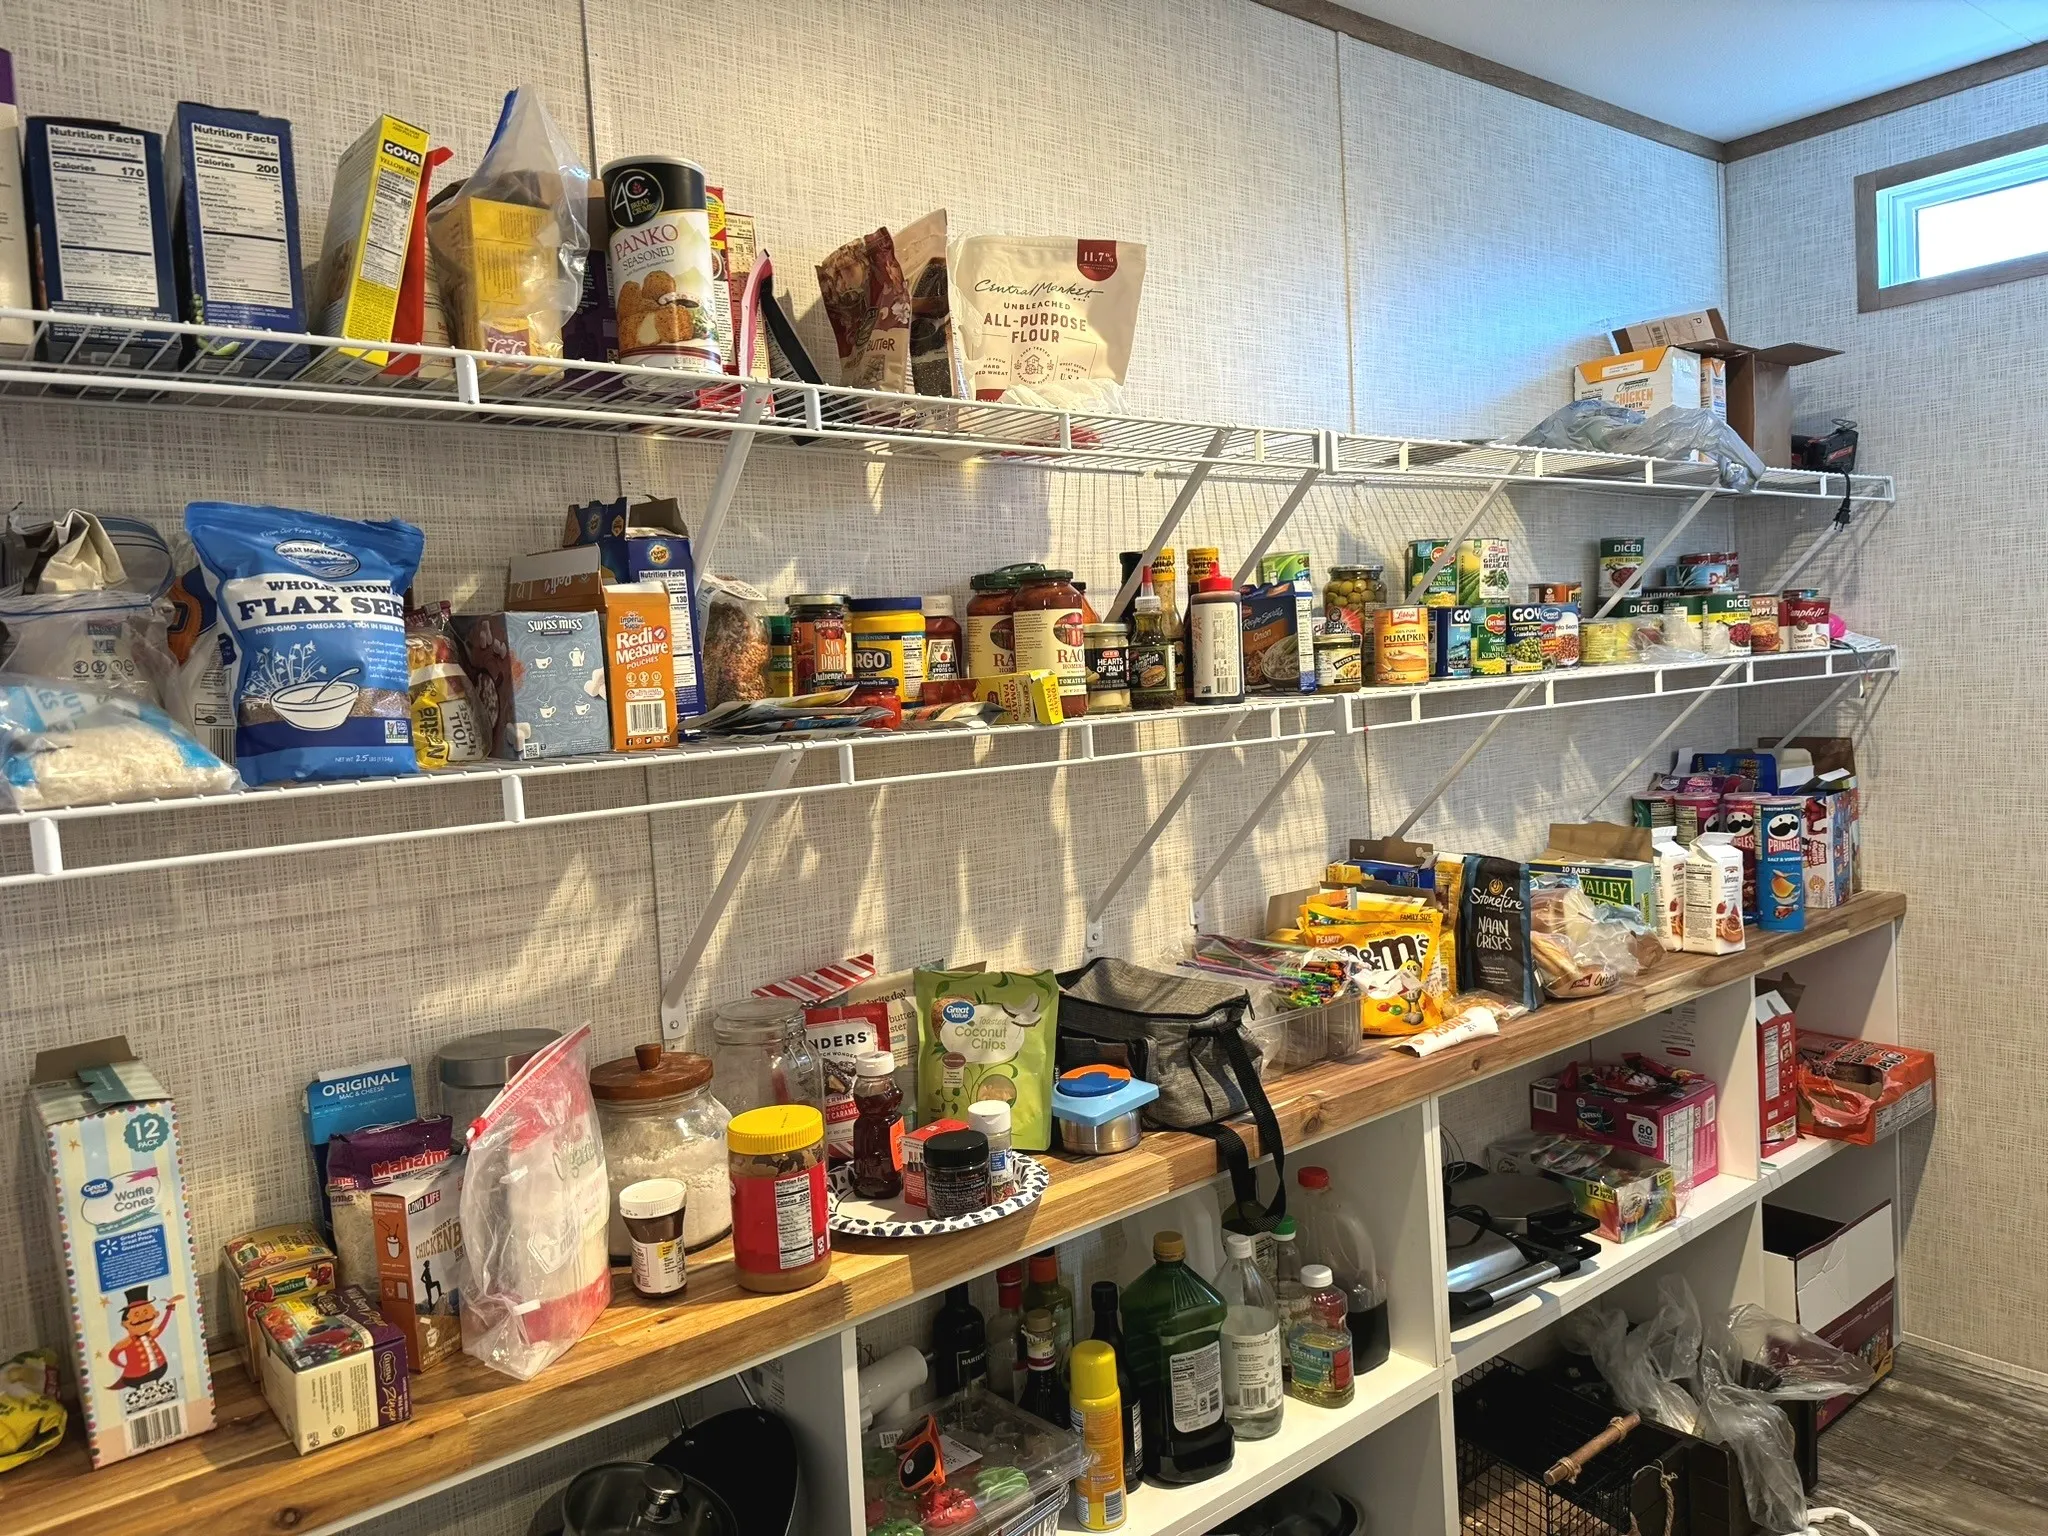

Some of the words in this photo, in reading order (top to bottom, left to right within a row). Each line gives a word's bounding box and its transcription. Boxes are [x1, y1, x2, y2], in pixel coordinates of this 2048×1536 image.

[50, 127, 104, 141] Nutrition
[108, 134, 142, 144] Facts
[193, 124, 243, 140] Nutrition
[246, 133, 277, 144] Facts
[384, 143, 420, 164] GOYA
[53, 161, 96, 172] Calories
[121, 166, 144, 177] 170
[196, 156, 235, 168] Calories
[256, 164, 279, 174] 200
[380, 156, 404, 171] YELLOW
[406, 166, 420, 177] RICE
[615, 224, 678, 261] PANKO
[622, 245, 674, 271] SEASONED
[1083, 251, 1114, 263] 11.7%
[974, 279, 1039, 296] Central
[1034, 282, 1104, 298] Market
[1004, 300, 1071, 310] UNBLEACHED
[984, 312, 1087, 332] ALL-PURPOSE
[1012, 329, 1060, 343] FLOUR
[1614, 388, 1653, 404] CHICKEN
[640, 571, 667, 579] Nutrition
[668, 570, 685, 578] Facts
[266, 580, 336, 592] WHOLE
[675, 595, 688, 604] 130
[237, 596, 342, 622] FLAX
[350, 596, 404, 619] SEE
[1396, 610, 1416, 621] Libby's
[1454, 609, 1471, 621] GO
[1512, 608, 1541, 621] GOY
[1630, 605, 1659, 613] DICED
[256, 625, 297, 634] NON-GMO
[527, 619, 558, 632] SWISS
[559, 618, 583, 630] MISS
[616, 626, 653, 649] Redi
[1253, 628, 1272, 642] Onion
[1383, 634, 1426, 643] PUMPKIN
[616, 642, 669, 665] Measure
[825, 640, 840, 654] SUN
[855, 652, 886, 668] RGO
[1057, 648, 1084, 663] RAO
[1097, 658, 1124, 666] HEARTS
[626, 656, 659, 670] POUCHES
[1108, 664, 1124, 672] PALM
[1009, 678, 1019, 721] TOMATO
[1046, 688, 1054, 713] PASTE
[1051, 683, 1059, 716] TOMATO
[449, 711, 468, 748] TOLL
[458, 703, 477, 756] HOUSE
[355, 754, 369, 762] 2.5
[1768, 837, 1800, 853] PRINGLES
[1581, 880, 1628, 903] VALLEY
[1469, 886, 1524, 913] Stonefire
[1478, 916, 1509, 936] NAAN
[1316, 935, 1340, 943] PEANUT
[947, 1005, 969, 1014] Great
[889, 1010, 915, 1024] butter
[979, 1017, 1008, 1026] Toasted
[954, 1026, 1007, 1037] Coconut
[1781, 1021, 1791, 1033] 20
[809, 1032, 867, 1049] NDERS
[971, 1038, 1006, 1050] Chips
[322, 1072, 399, 1097] ORIGINAL
[361, 1086, 384, 1096] CHEESE
[132, 1119, 161, 1141] 12
[1638, 1124, 1653, 1136] 60
[138, 1139, 159, 1149] PACK
[1638, 1134, 1654, 1142] PACKS
[1659, 1175, 1665, 1183] 12
[84, 1182, 108, 1193] Great
[115, 1186, 153, 1202] Waffle
[1588, 1184, 1599, 1196] 12
[114, 1195, 156, 1213] Cones
[374, 1201, 402, 1209] INSTRUCTIONS
[408, 1199, 424, 1215] LONO
[425, 1190, 440, 1206] LIFE
[777, 1198, 797, 1206] Calories
[799, 1192, 809, 1201] 200
[138, 1228, 161, 1237] Quality.
[432, 1218, 451, 1235] SAVORY
[121, 1239, 138, 1247] Great
[139, 1234, 153, 1242] Price.
[121, 1239, 158, 1251] Guaranteed.
[416, 1225, 452, 1259] CHICKEN
